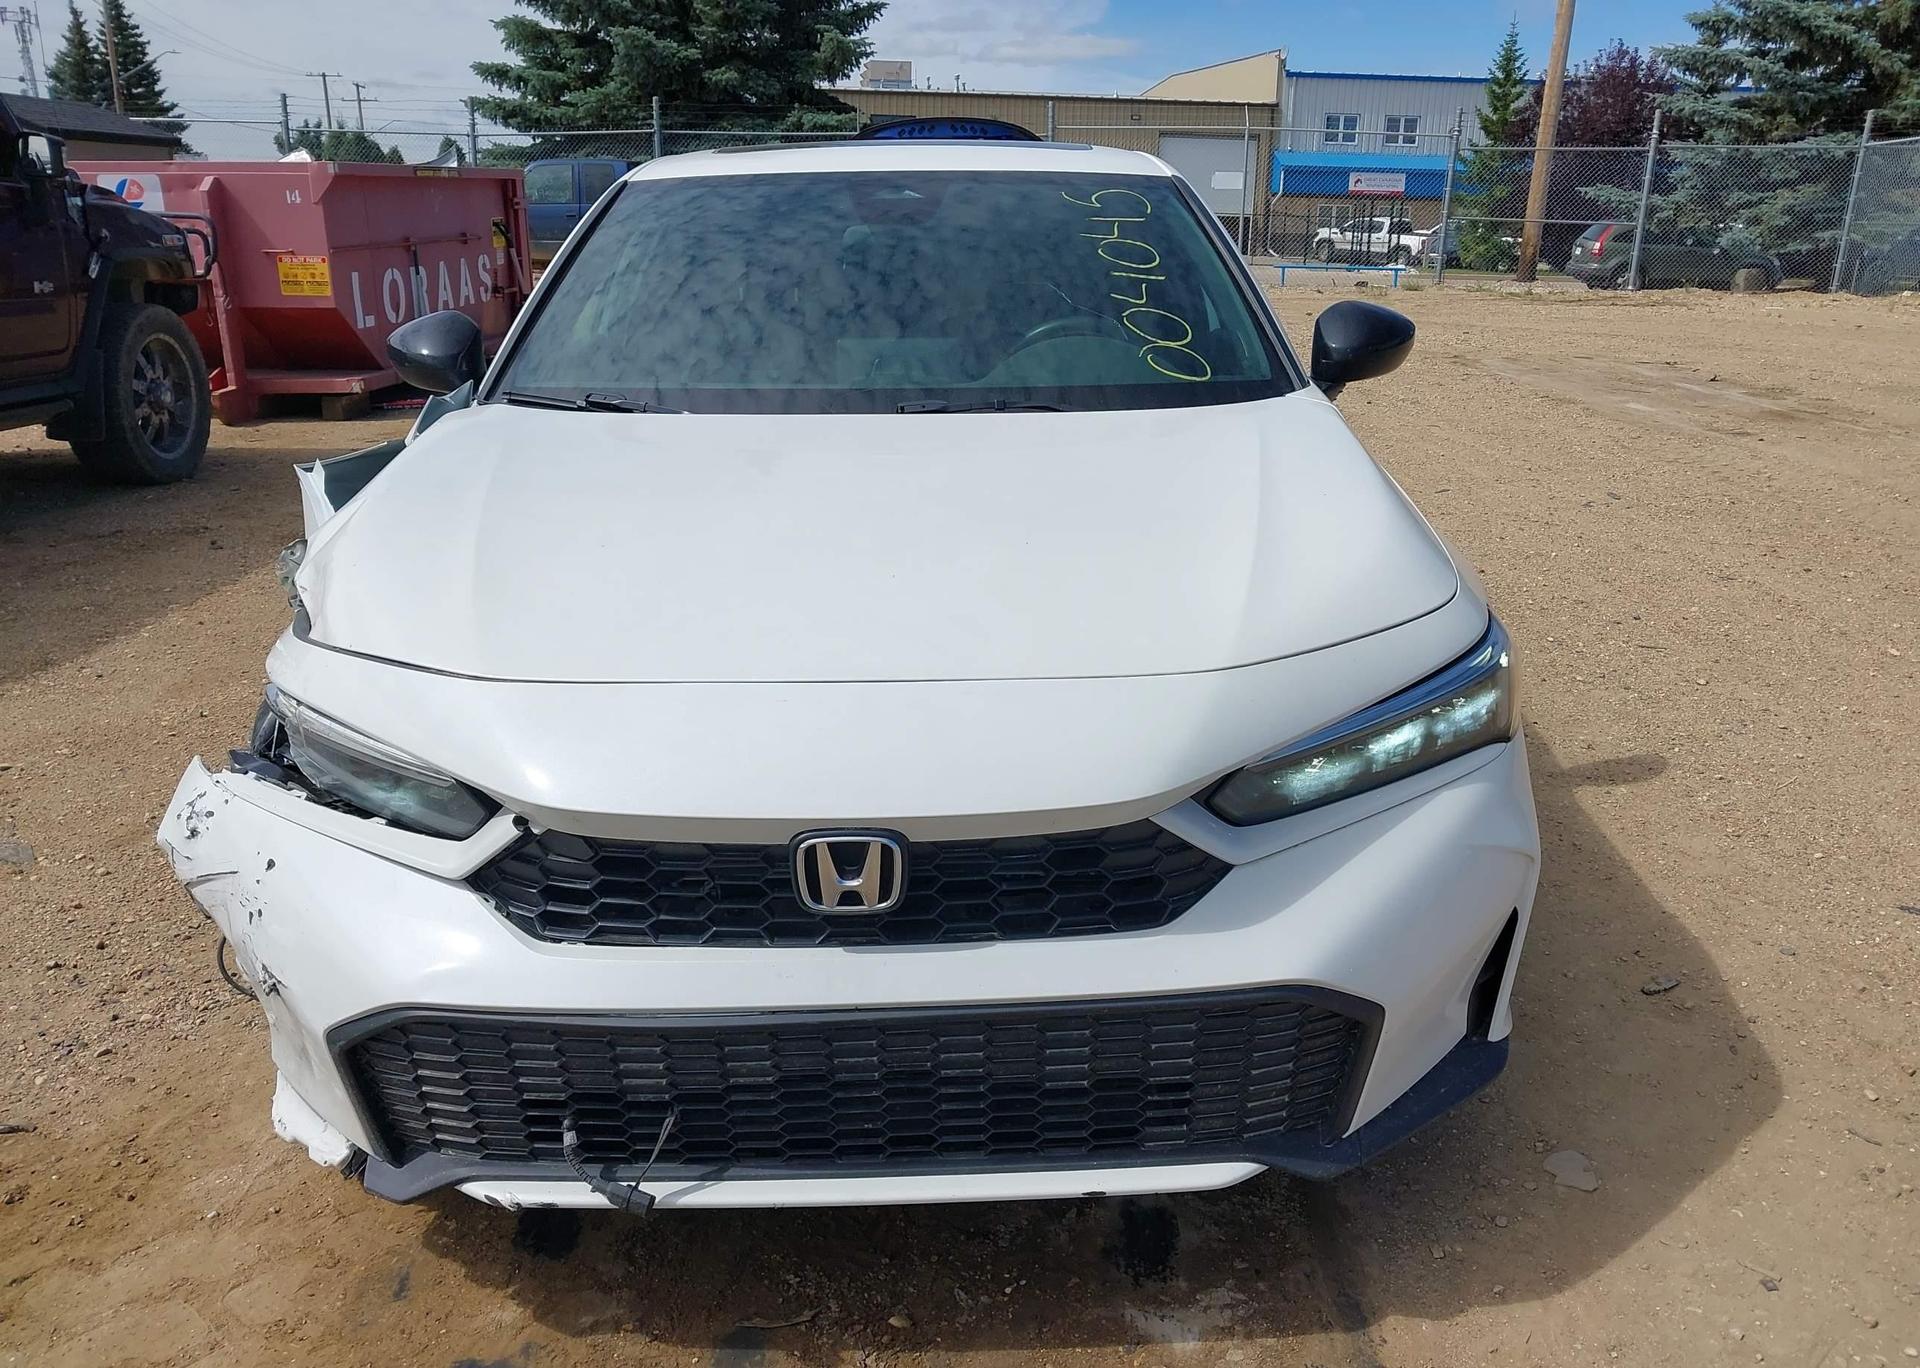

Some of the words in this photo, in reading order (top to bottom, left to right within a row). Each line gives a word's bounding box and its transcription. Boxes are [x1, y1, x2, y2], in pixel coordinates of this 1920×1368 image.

[286, 189, 301, 204] 14
[351, 254, 492, 329] LORAAS
[1061, 189, 1211, 381] 0041045
